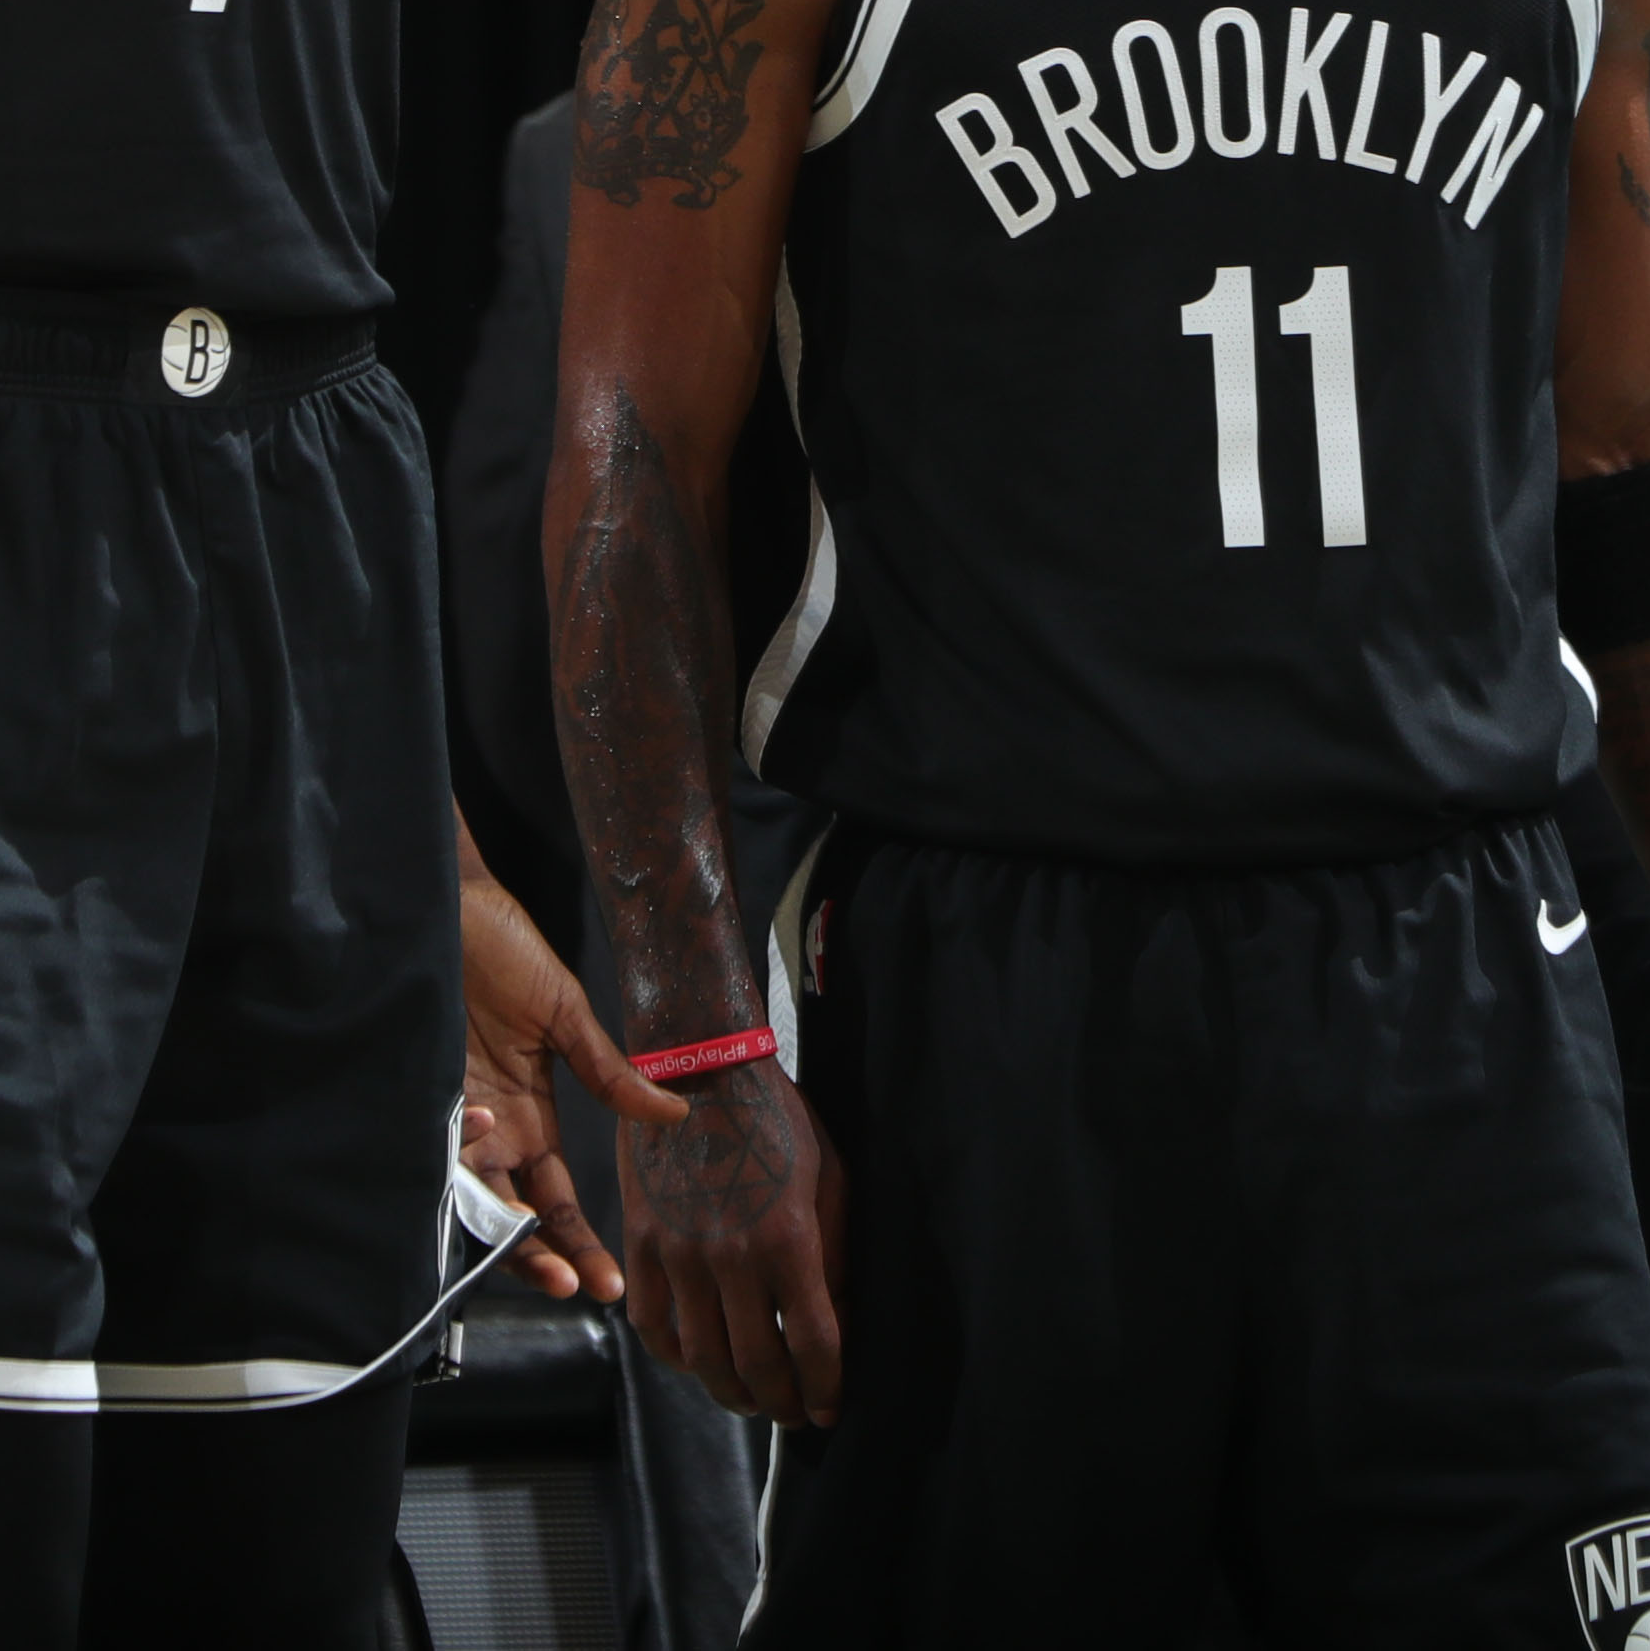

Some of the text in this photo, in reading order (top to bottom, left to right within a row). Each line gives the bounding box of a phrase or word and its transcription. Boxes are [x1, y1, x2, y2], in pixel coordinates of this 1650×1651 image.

[934, 6, 1545, 239] BROOKLYN
[185, 319, 209, 384] B
[1180, 265, 1367, 548] 11
